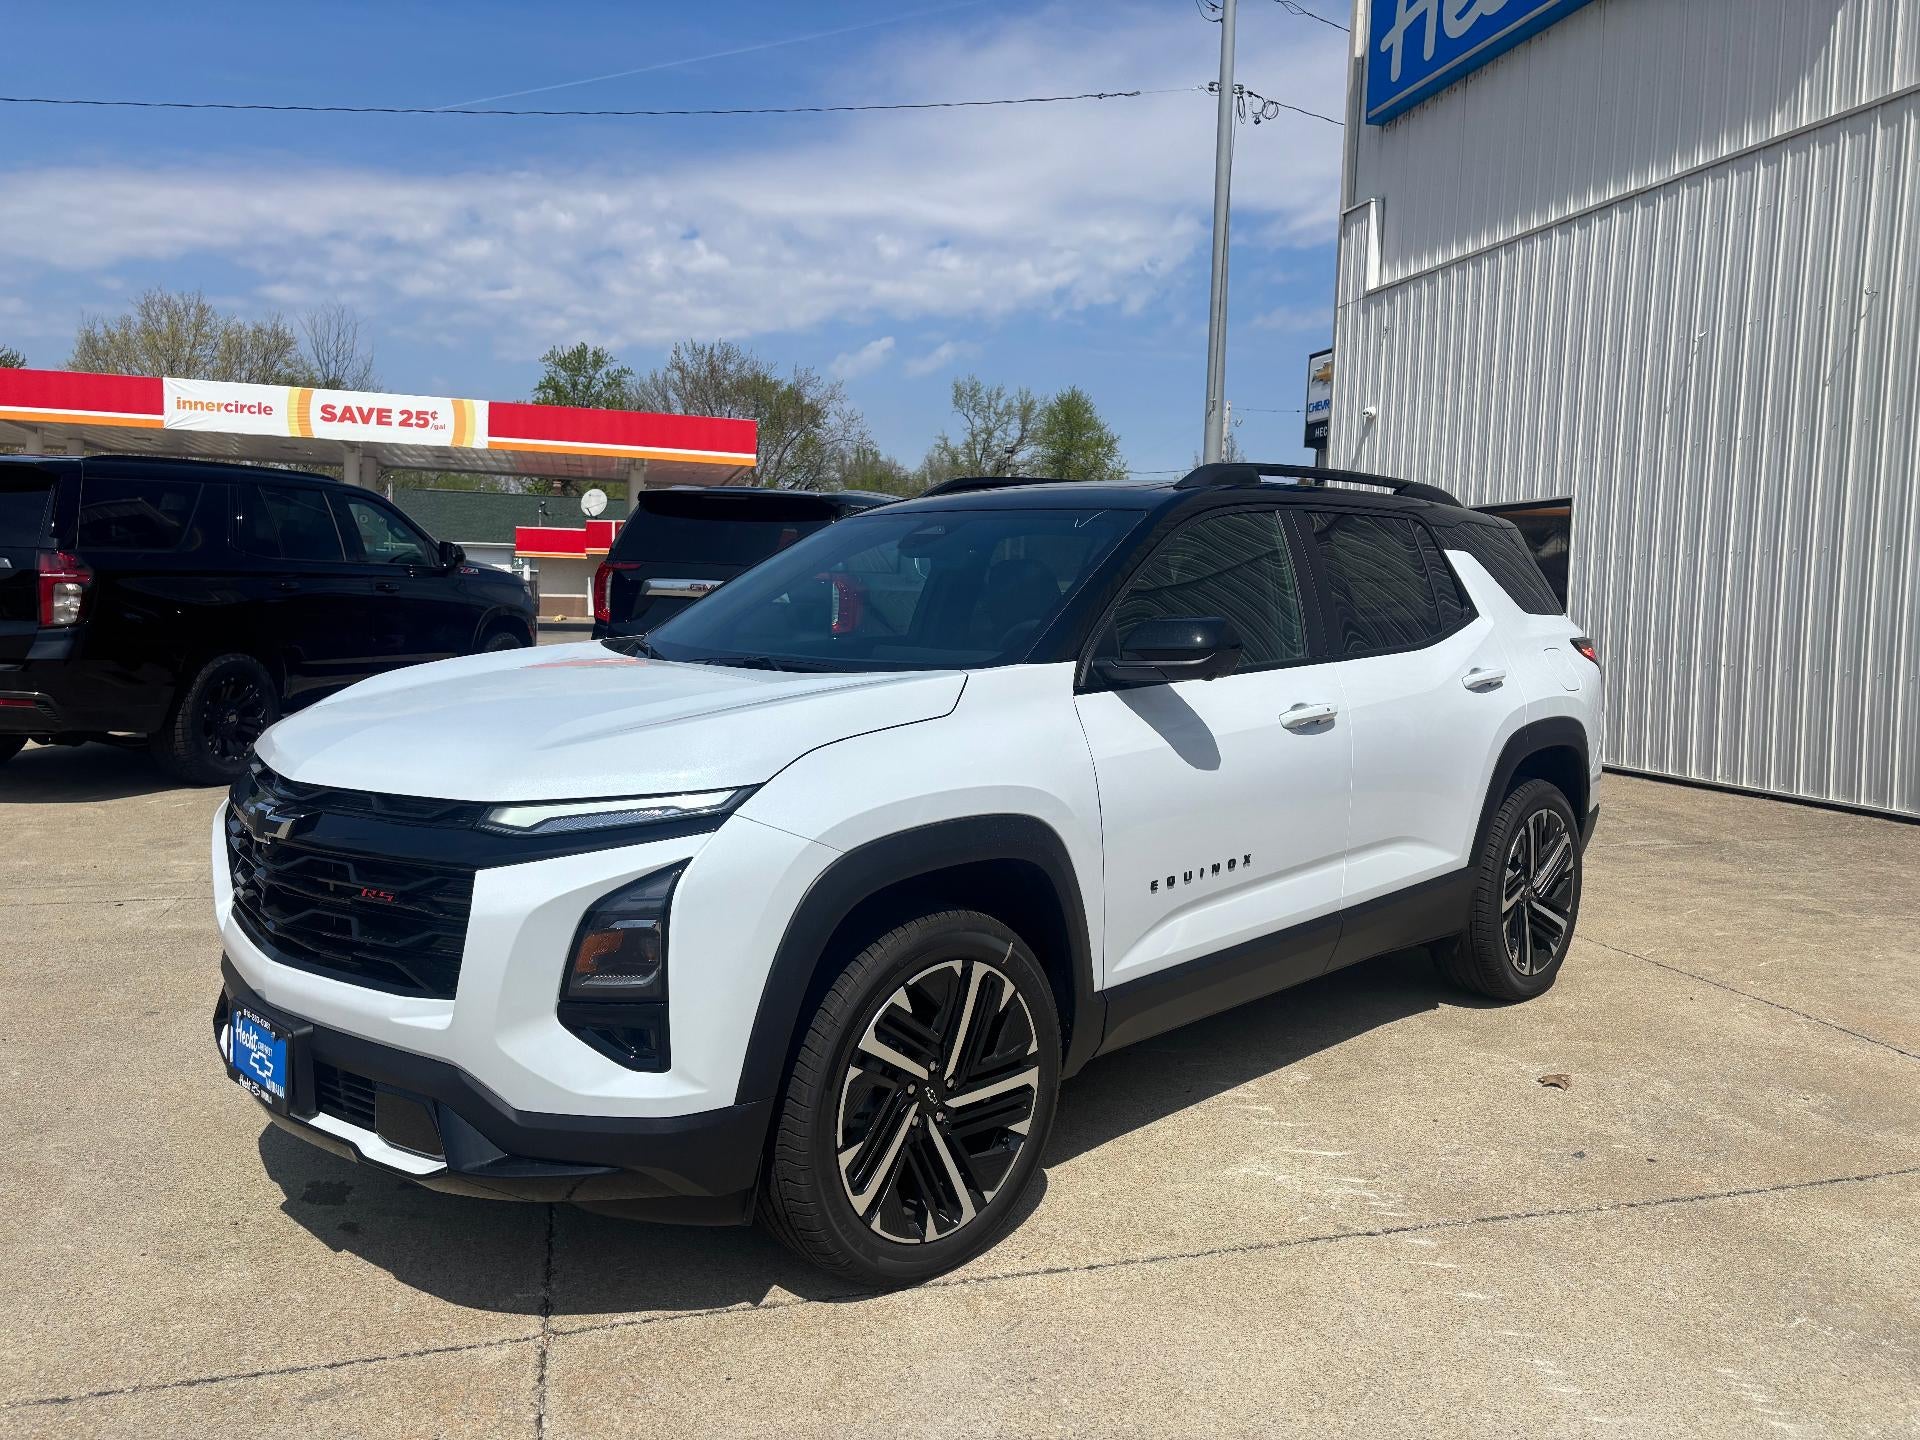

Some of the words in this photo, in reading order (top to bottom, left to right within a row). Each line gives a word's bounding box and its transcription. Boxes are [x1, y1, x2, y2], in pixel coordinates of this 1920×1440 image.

[176, 396, 274, 416] innercircle
[319, 403, 393, 427] SAVE
[398, 409, 439, 429] 25¢
[1150, 853, 1251, 891] EQUINOX
[361, 886, 395, 903] RS
[235, 1015, 259, 1052] Hecht
